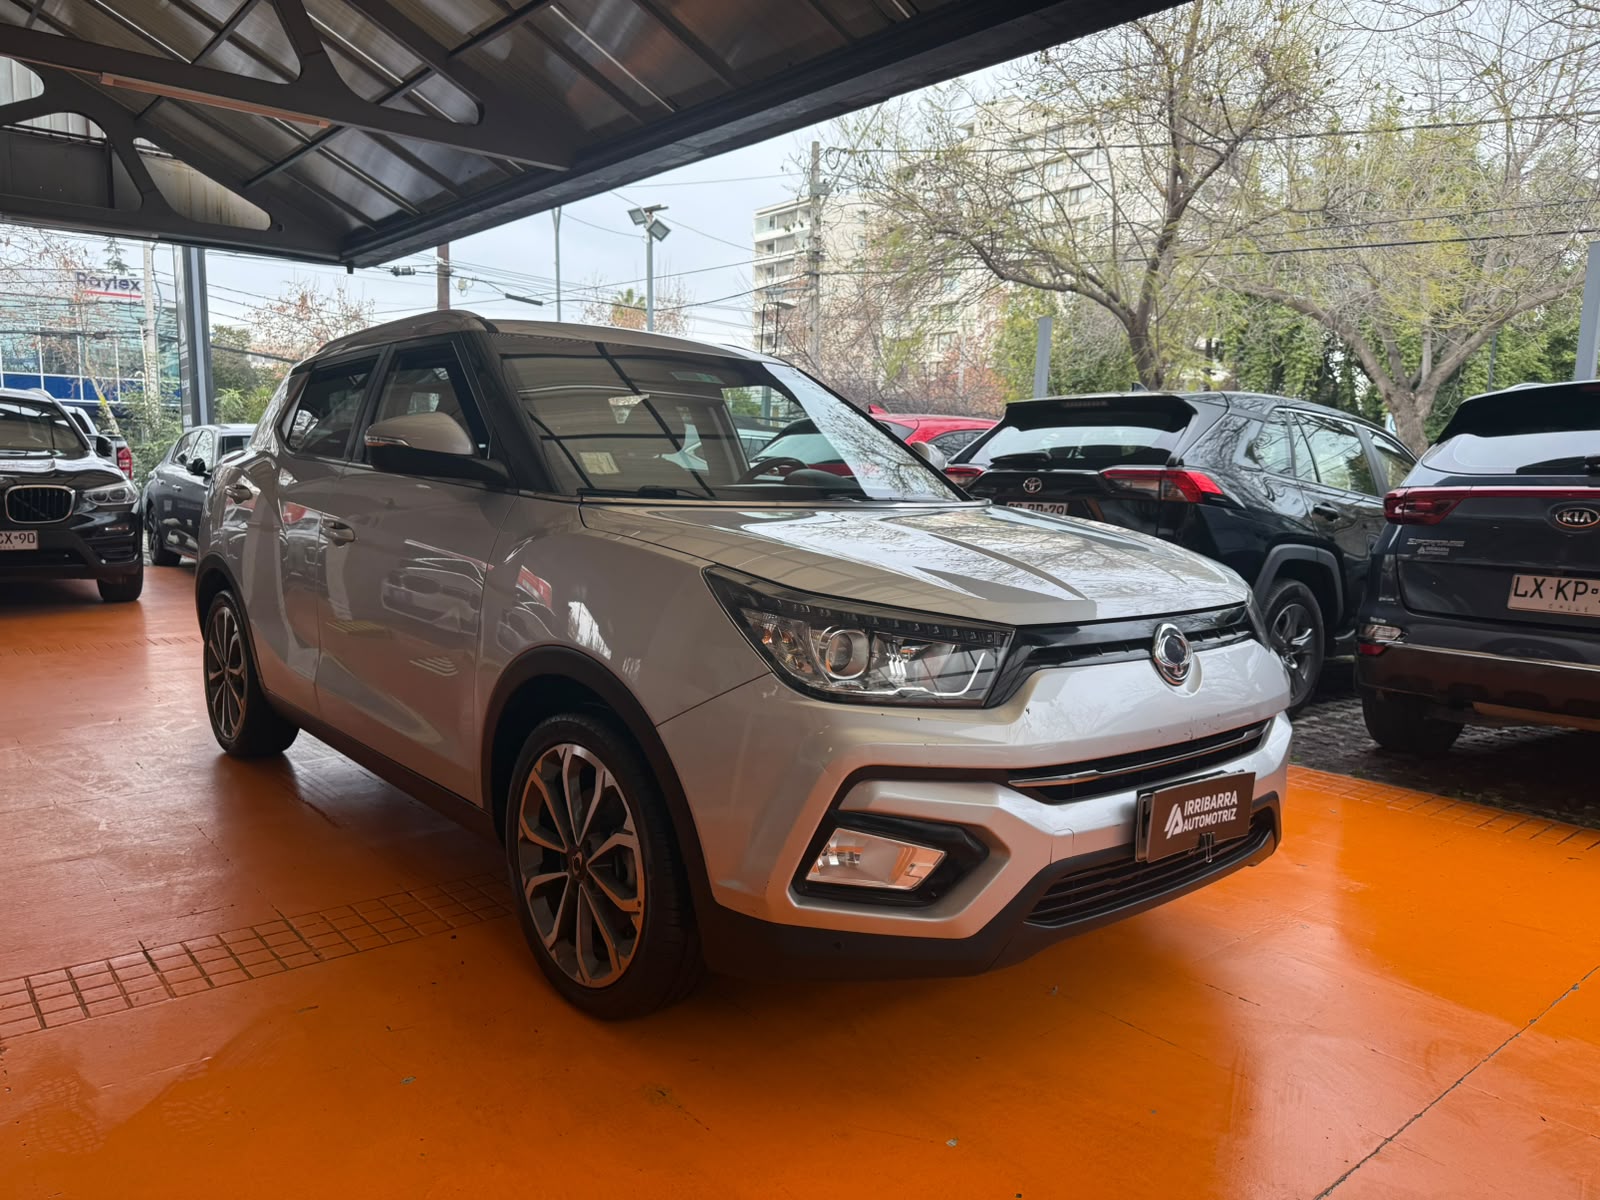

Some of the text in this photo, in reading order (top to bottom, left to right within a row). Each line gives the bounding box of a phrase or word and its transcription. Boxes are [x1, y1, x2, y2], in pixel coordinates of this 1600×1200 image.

[1562, 511, 1592, 523] KIA
[1183, 790, 1238, 817] IRRIBARRA
[1182, 807, 1237, 832] AUTOMOTRIZ
